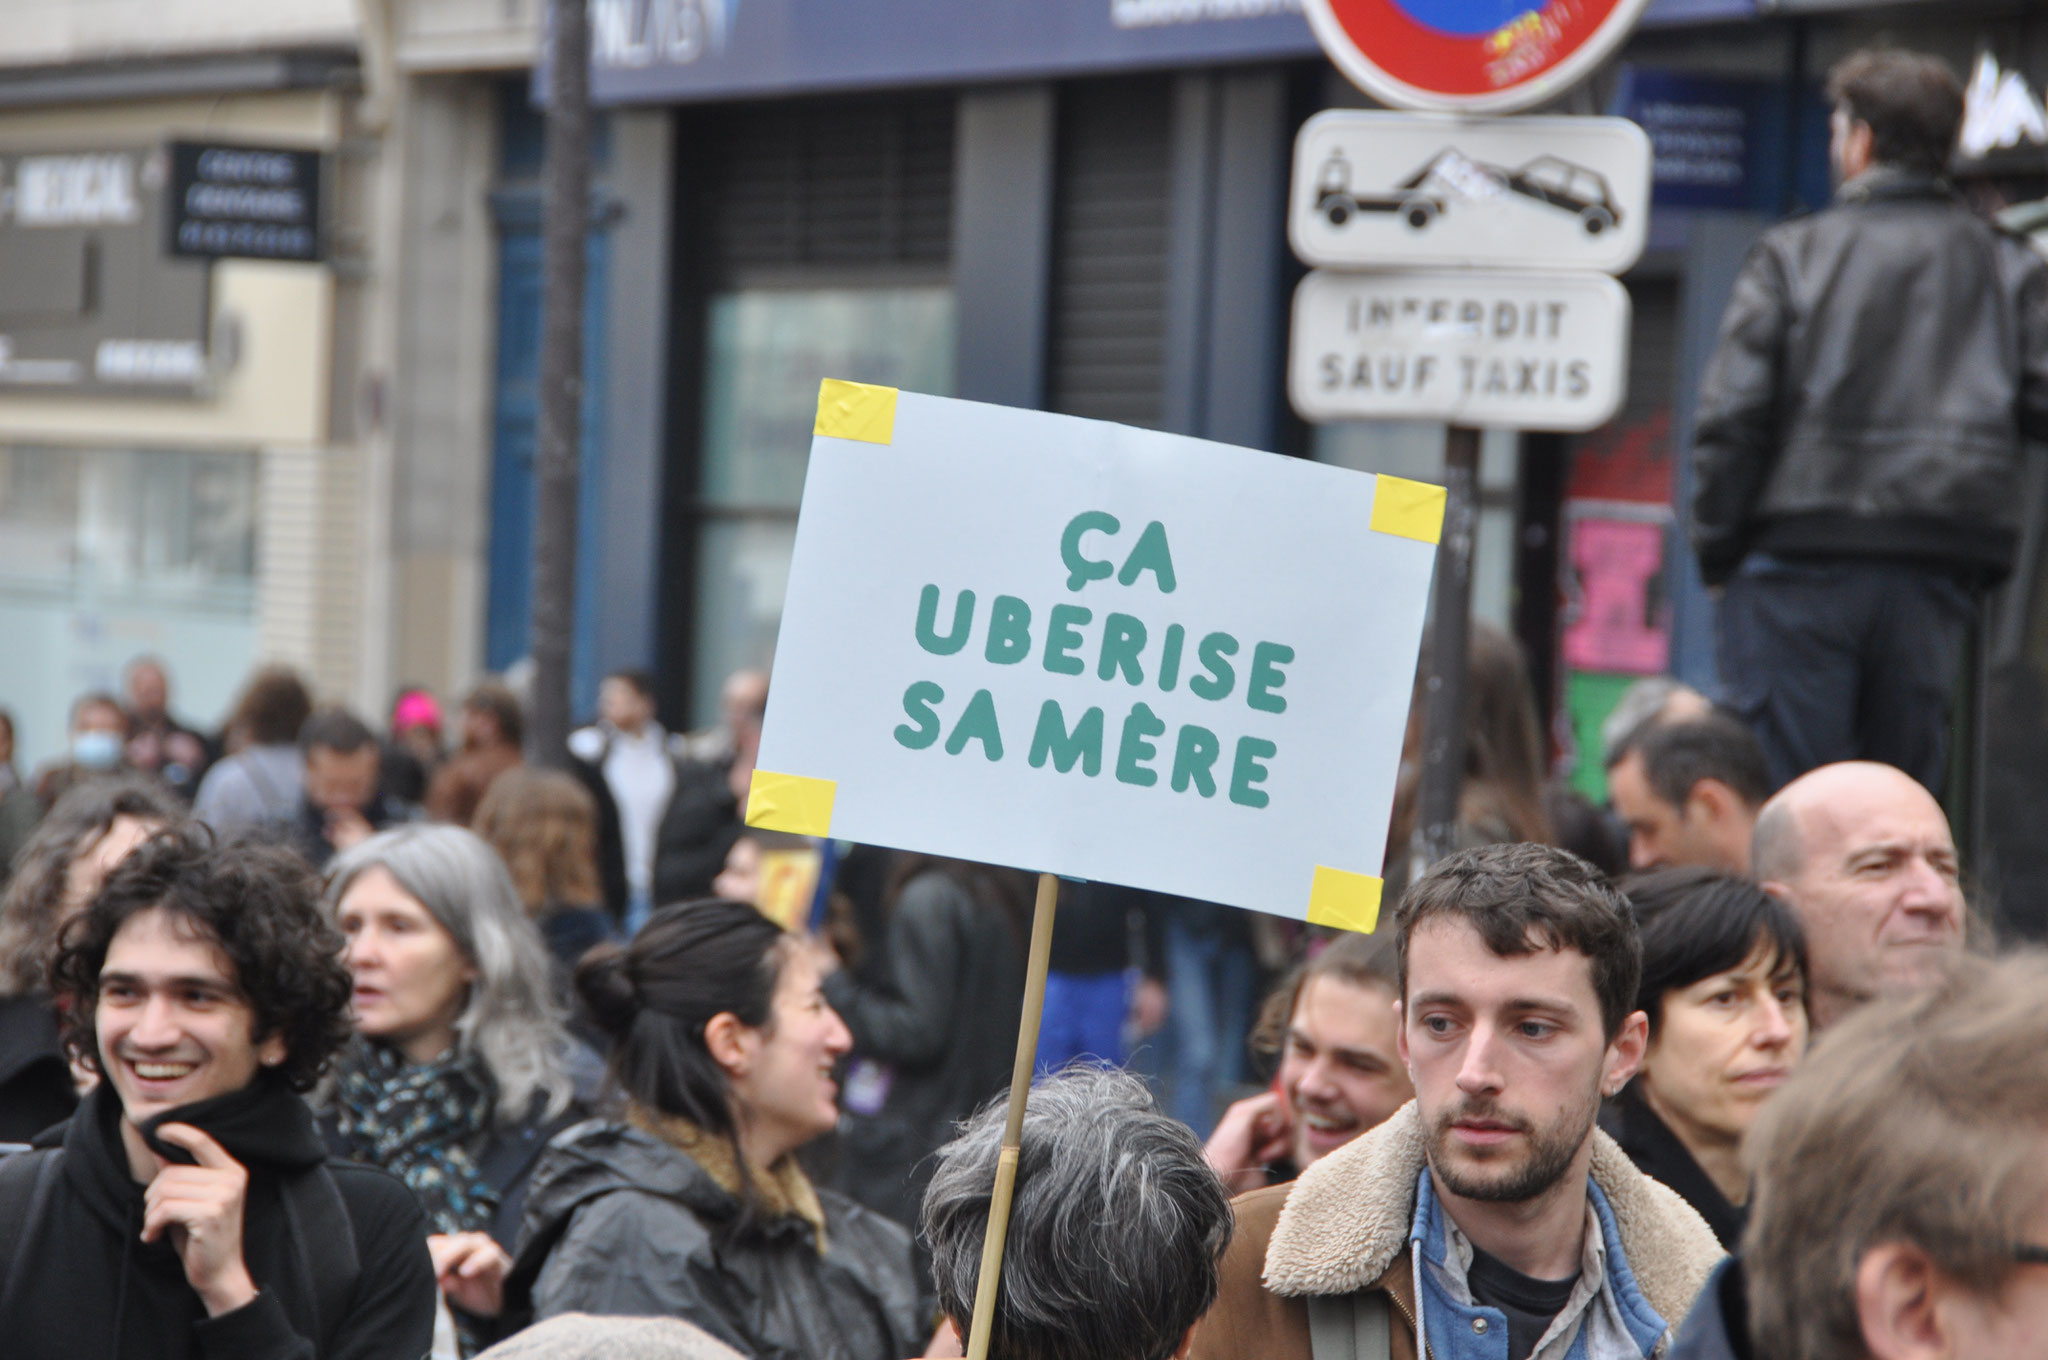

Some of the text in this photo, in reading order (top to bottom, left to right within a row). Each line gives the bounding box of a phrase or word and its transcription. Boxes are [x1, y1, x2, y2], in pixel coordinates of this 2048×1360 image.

[1319, 353, 1591, 398] SAUF TAXIS
[1060, 511, 1176, 593] ÇA
[915, 584, 1295, 714] UBERISE
[894, 681, 1277, 809] SA MÈRE
